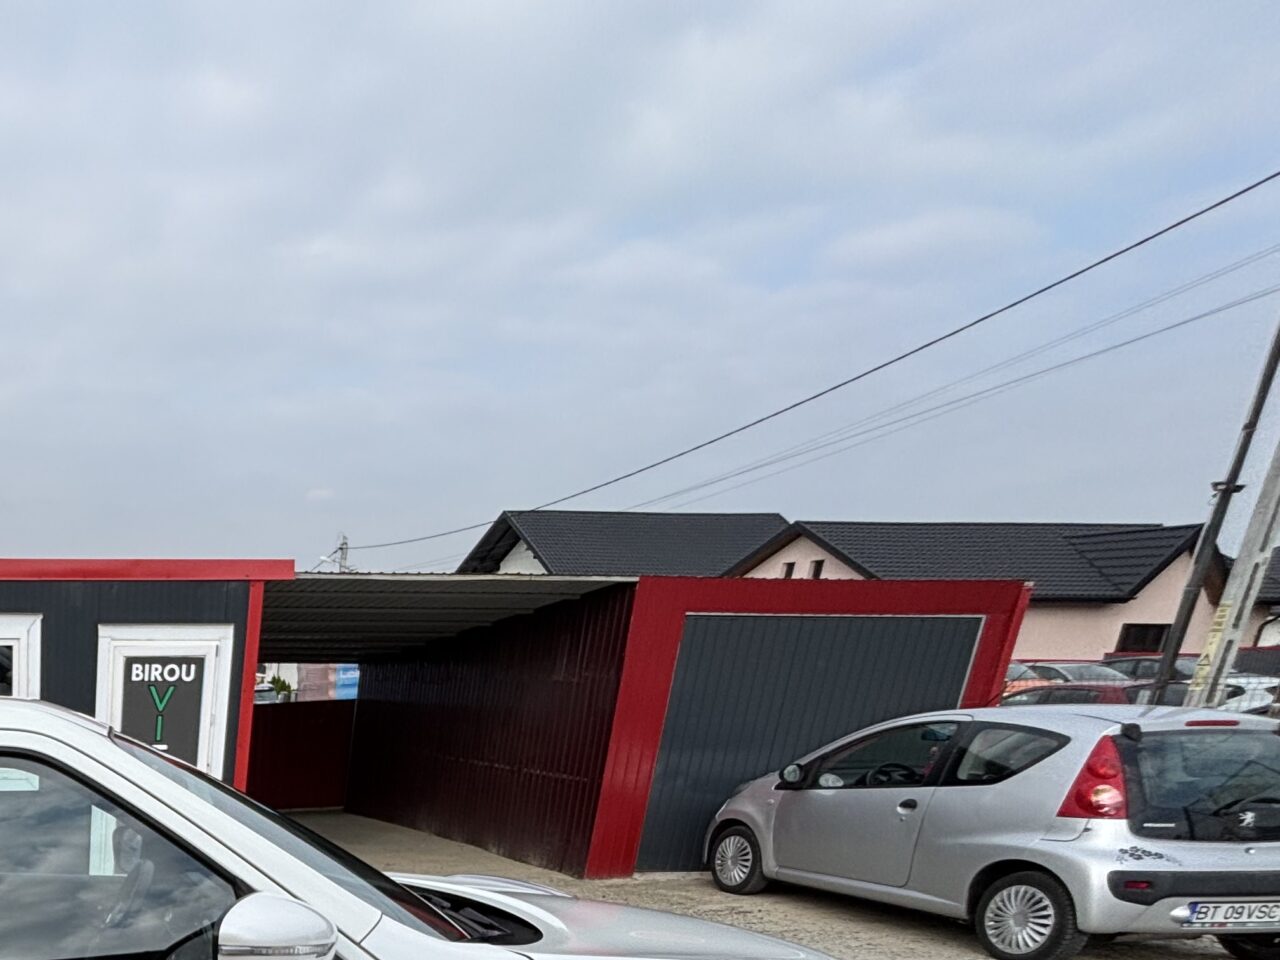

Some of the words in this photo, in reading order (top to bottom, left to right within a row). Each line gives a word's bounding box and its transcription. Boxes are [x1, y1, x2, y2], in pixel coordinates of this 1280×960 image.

[131, 663, 196, 682] BIROU
[1196, 905, 1221, 920] BT
[1224, 905, 1246, 920] 09
